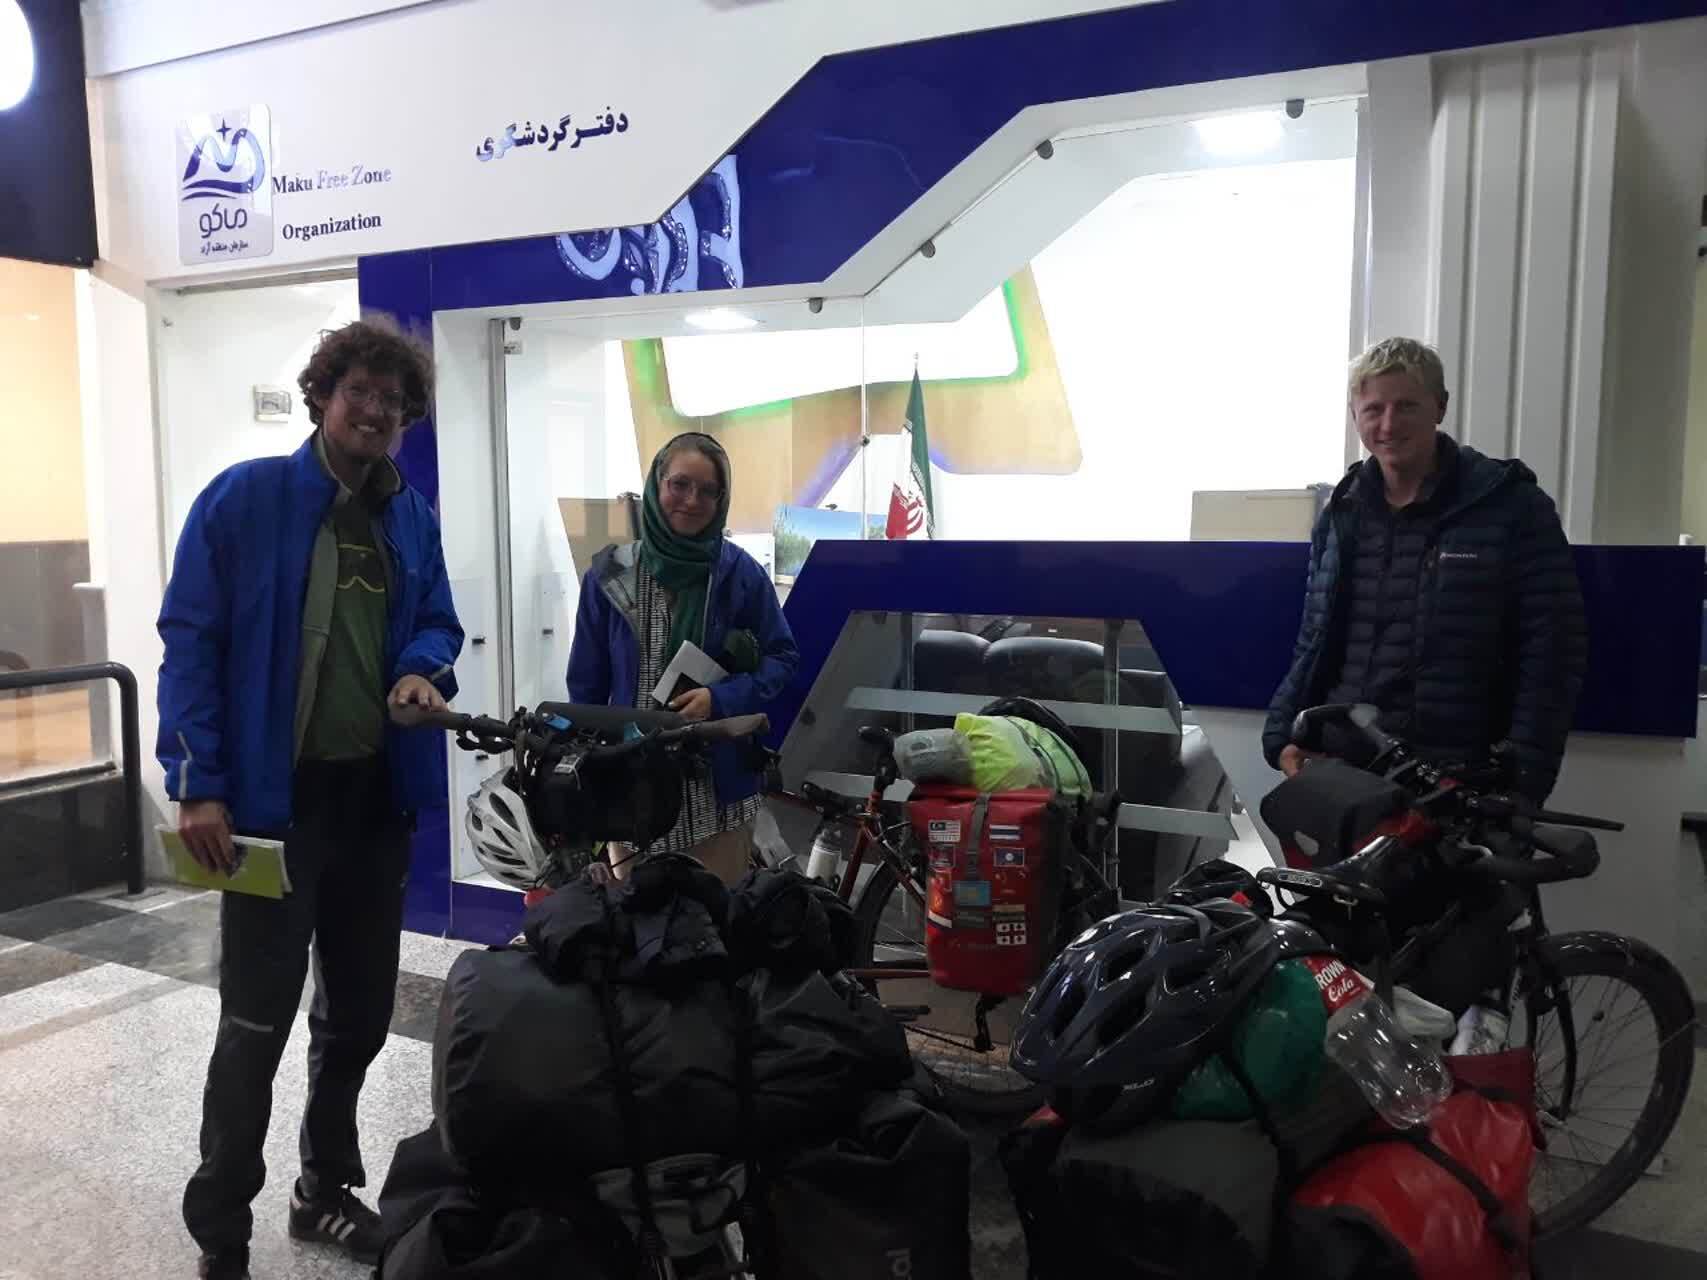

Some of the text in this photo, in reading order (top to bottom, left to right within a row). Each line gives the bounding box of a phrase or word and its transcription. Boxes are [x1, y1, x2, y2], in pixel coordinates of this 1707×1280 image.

[475, 106, 629, 162] دفتر گردشگری
[272, 165, 392, 194] Maku Free Zone
[282, 213, 382, 241] Organization
[1314, 959, 1347, 992] ROWN
[1328, 978, 1356, 1002] Cola
